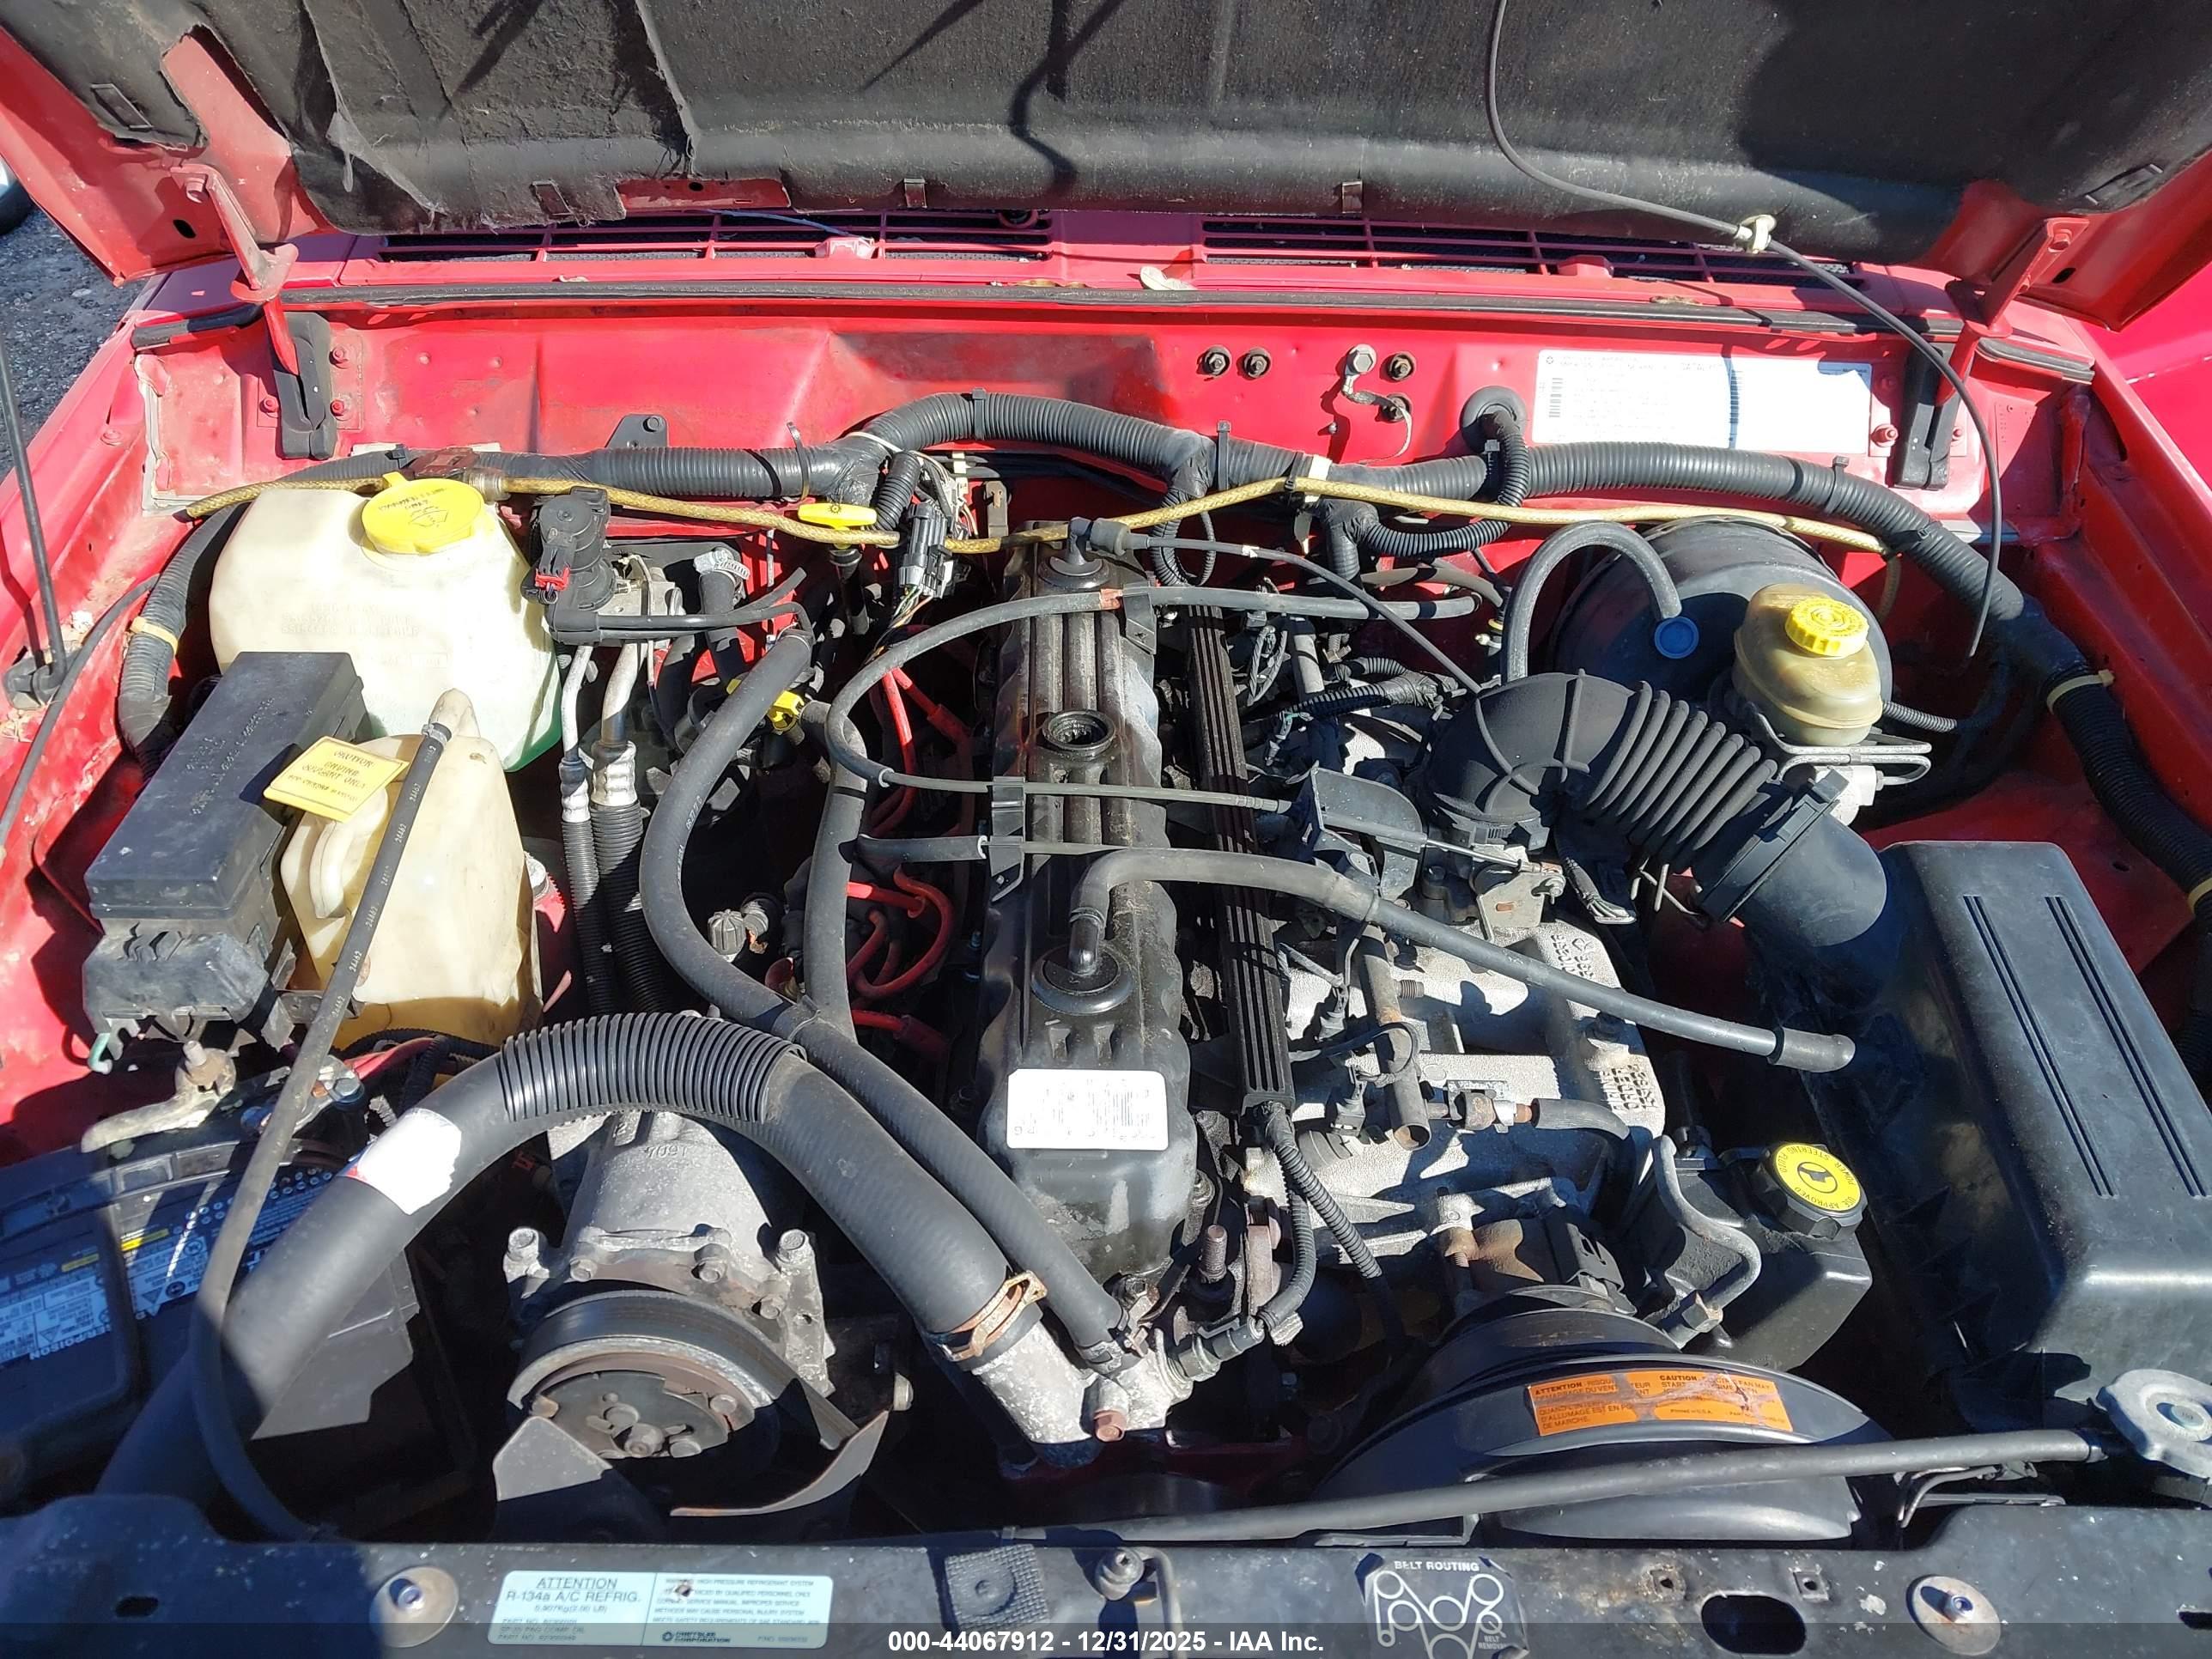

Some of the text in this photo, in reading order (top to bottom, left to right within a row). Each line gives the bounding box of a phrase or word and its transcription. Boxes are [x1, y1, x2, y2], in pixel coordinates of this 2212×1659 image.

[1778, 1146, 1856, 1186] POWER STEERING FLUID
[1795, 1187, 1839, 1209] APPROVED
[1535, 1382, 1583, 1395] ATTENTION
[1540, 1408, 1589, 1423] D'ALLUMAGE
[1394, 1560, 1480, 1572] BELT ROUTING
[536, 1577, 617, 1589] ATTENTION
[506, 1590, 641, 1603] R-134a A/C REFRIG.
